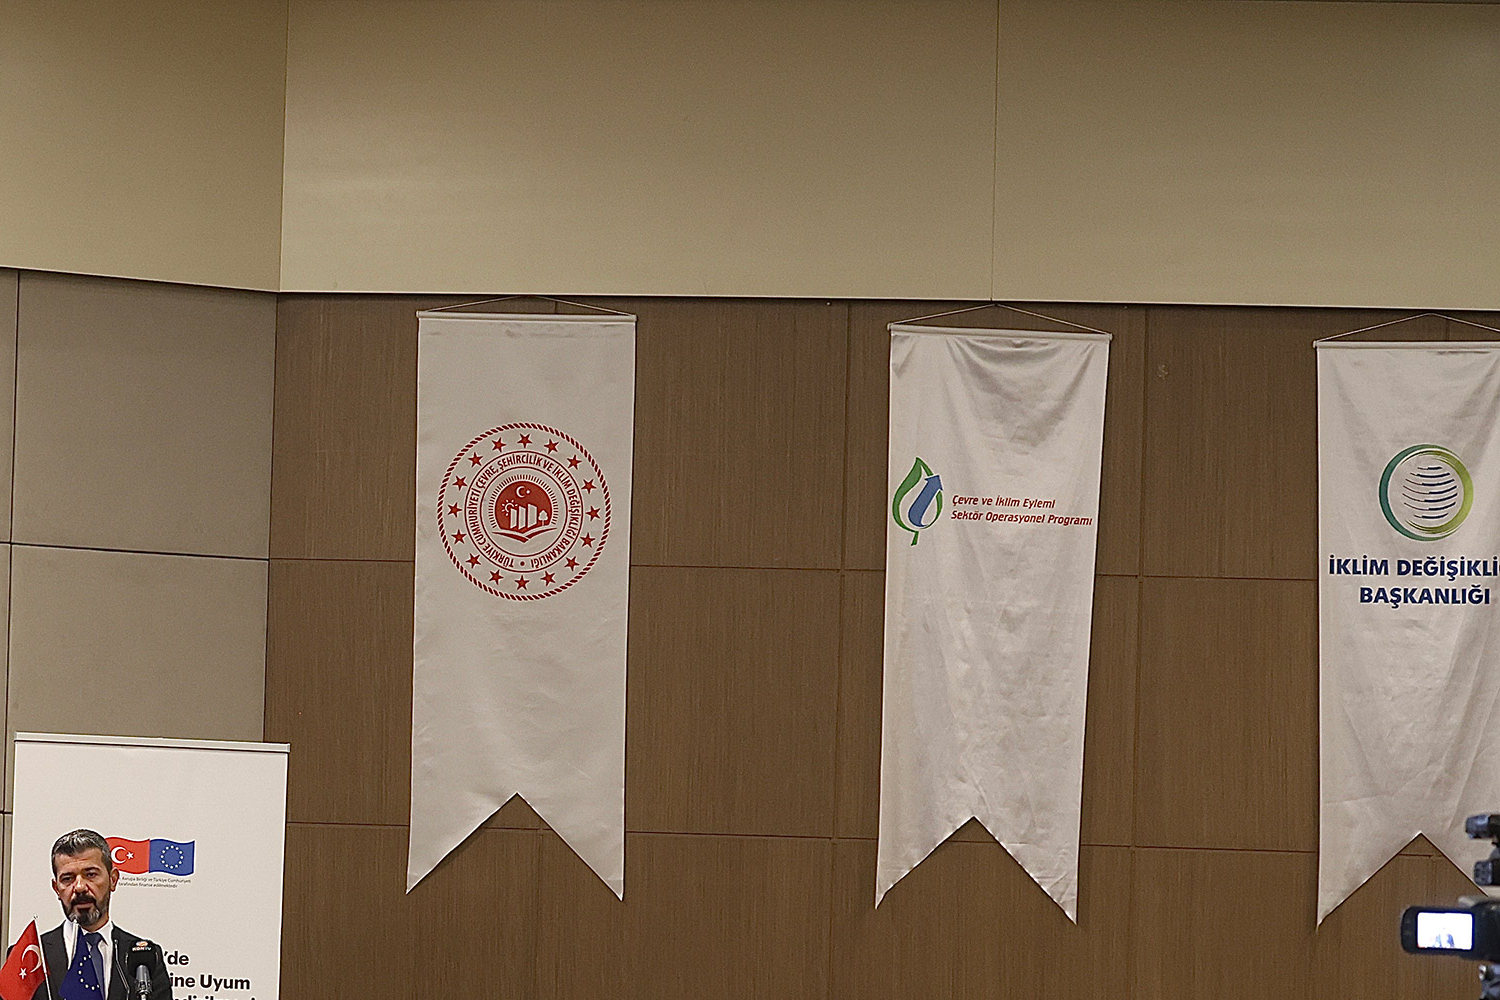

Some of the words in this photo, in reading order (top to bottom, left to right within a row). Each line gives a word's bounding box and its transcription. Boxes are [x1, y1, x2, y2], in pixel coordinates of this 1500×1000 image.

[497, 453, 544, 471] ŞEHİRCİLİK
[543, 458, 554, 471] VE
[552, 465, 573, 487] İKLİM
[565, 486, 581, 540] DEĞİŞİKLİĞİ
[952, 495, 978, 506] Çevre
[981, 497, 993, 506] ve
[995, 495, 1020, 507] İklim
[1022, 498, 1056, 509] Eylemi
[467, 487, 486, 546] CUMHURİYETİ
[951, 510, 983, 521] Sektör
[985, 511, 1045, 524] Operasyonel
[1047, 514, 1093, 526] Programı
[482, 543, 514, 568] TÜRKİYE
[530, 538, 570, 568] BAKANLIĞI
[1329, 554, 1389, 576] İKLİM
[1396, 556, 1500, 581] DEĞİŞİKLİ
[1360, 584, 1491, 609] BAŞKANLIĞI
[164, 951, 189, 966] 'de
[169, 972, 196, 988] ine
[199, 974, 251, 992] Uyum
